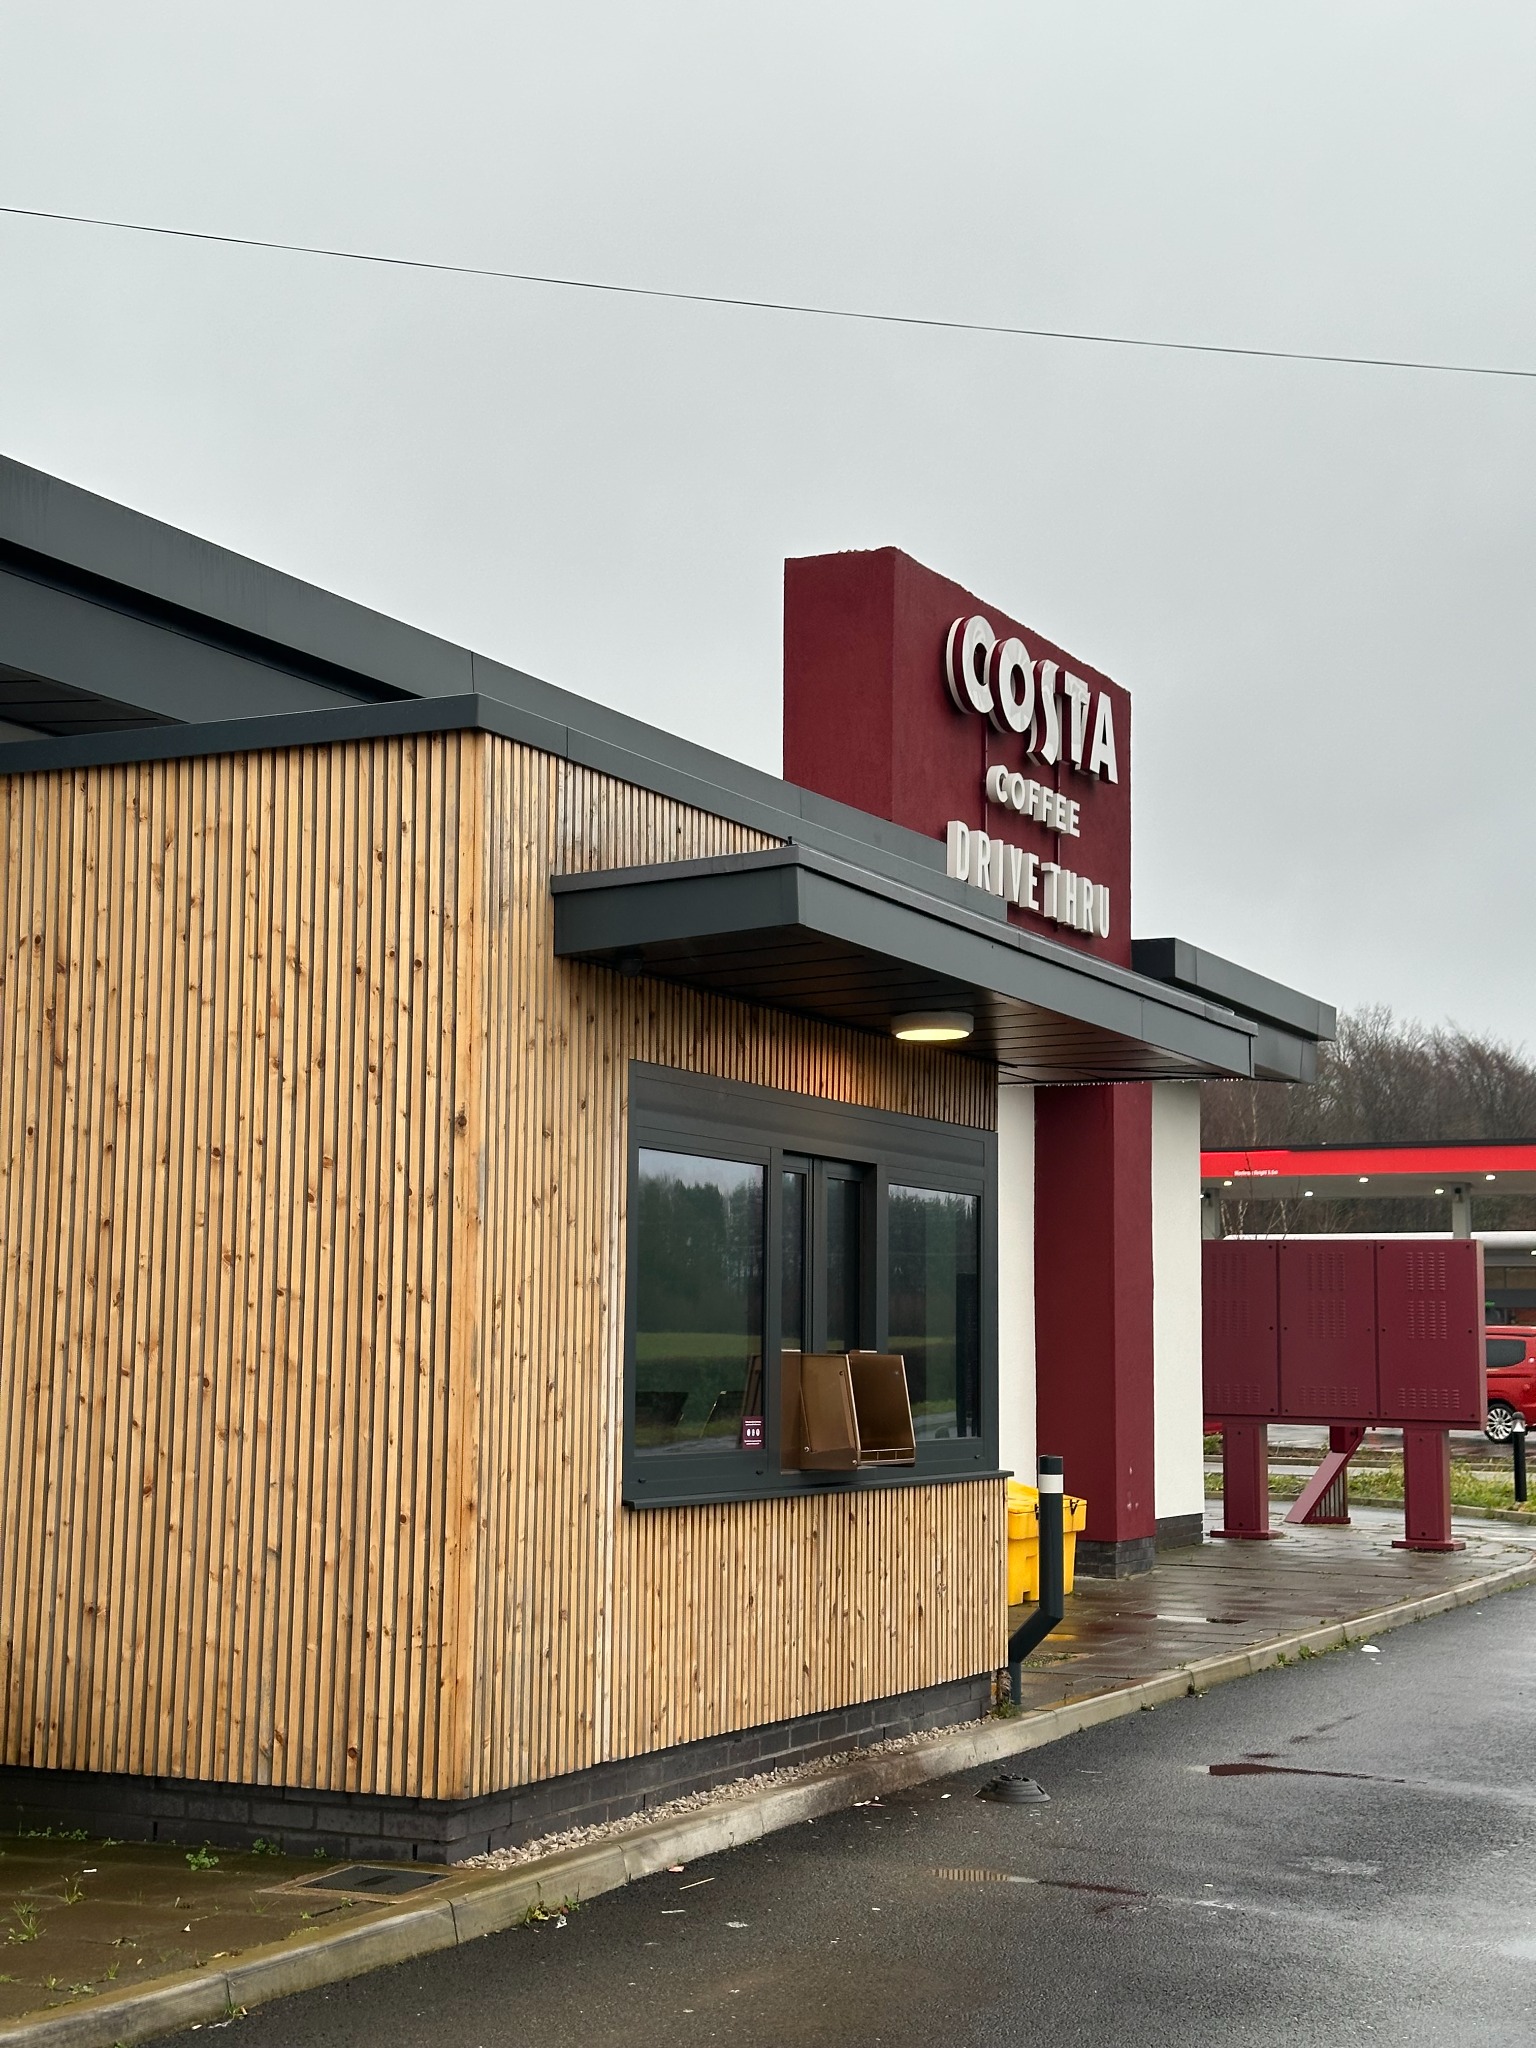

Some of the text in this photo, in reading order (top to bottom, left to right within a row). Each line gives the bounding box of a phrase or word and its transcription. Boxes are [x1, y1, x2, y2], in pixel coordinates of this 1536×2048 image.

[946, 615, 1119, 785] COSTA
[986, 764, 1081, 838] COFFEE
[946, 820, 1110, 939] DRIVE THRU
